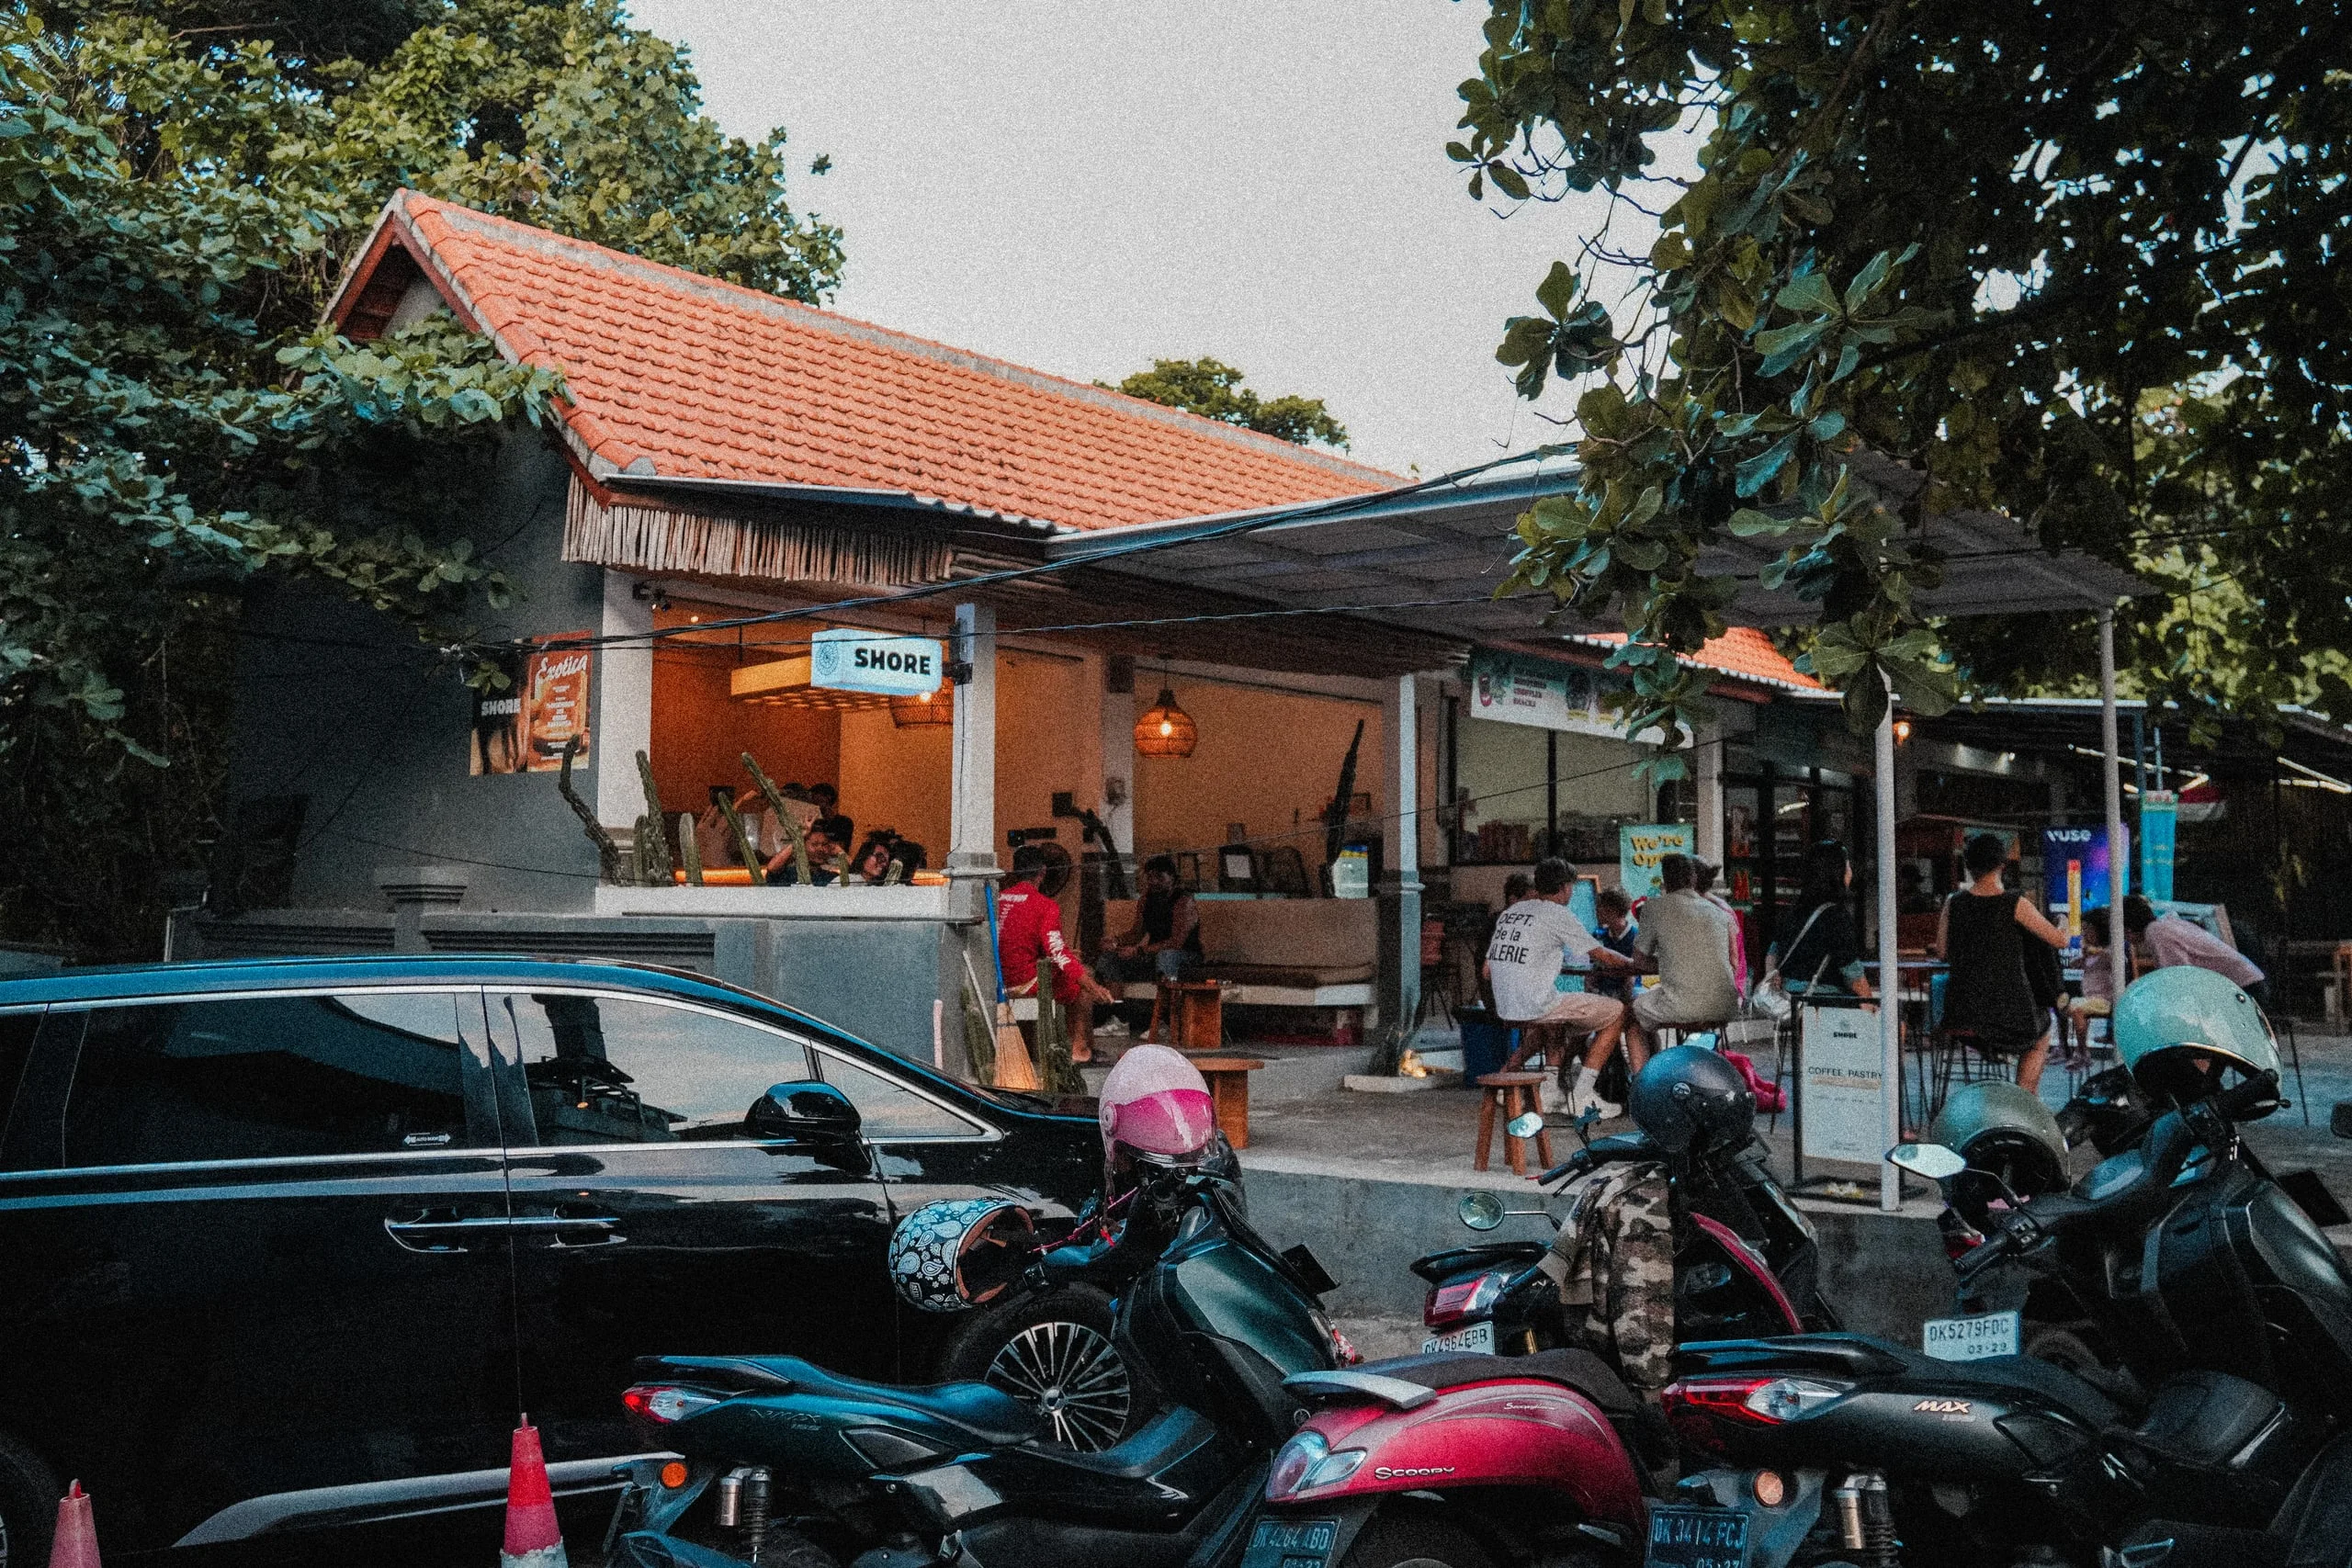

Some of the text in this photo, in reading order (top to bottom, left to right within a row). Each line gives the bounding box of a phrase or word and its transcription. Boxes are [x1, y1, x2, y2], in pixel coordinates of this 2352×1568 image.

[535, 654, 588, 685] Exotica
[854, 648, 931, 676] SHORE
[481, 698, 522, 716] SHORE
[1631, 834, 1684, 851] We're
[1498, 912, 1533, 927] DEPT.
[1495, 927, 1521, 942] de la
[1914, 1400, 1973, 1415] MAX
